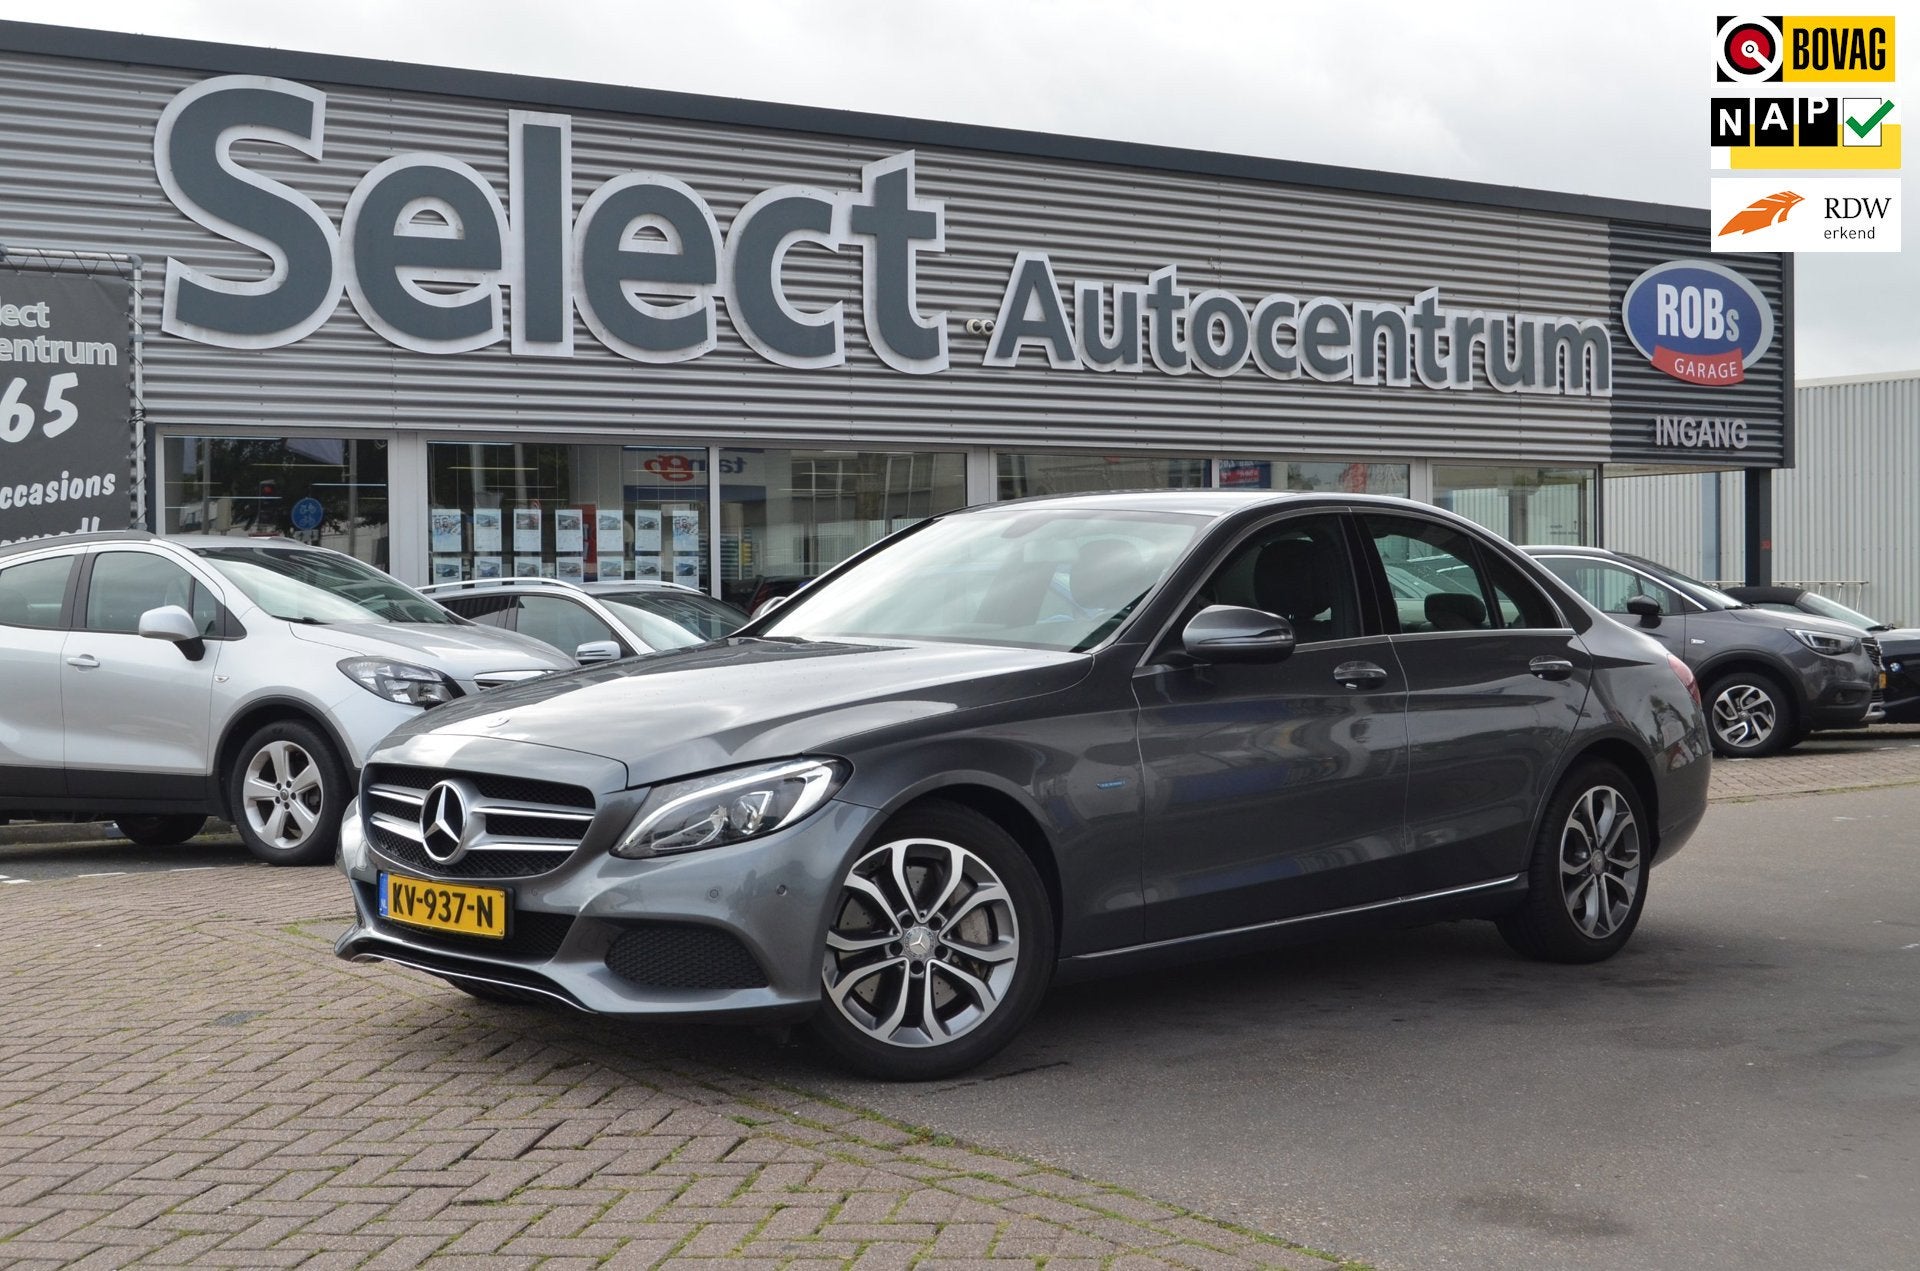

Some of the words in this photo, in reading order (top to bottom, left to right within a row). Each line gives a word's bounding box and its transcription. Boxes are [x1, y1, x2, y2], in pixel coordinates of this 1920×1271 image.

[154, 74, 950, 375] Select
[982, 251, 1613, 397] Autocentrum
[0, 301, 50, 329] ect
[1657, 283, 1740, 343] ROBs
[0, 335, 117, 366] entrum
[1674, 357, 1738, 380] GARAGE
[0, 372, 79, 443] 65
[1655, 415, 1749, 450] INGANG
[392, 882, 493, 929] KV-937-N
